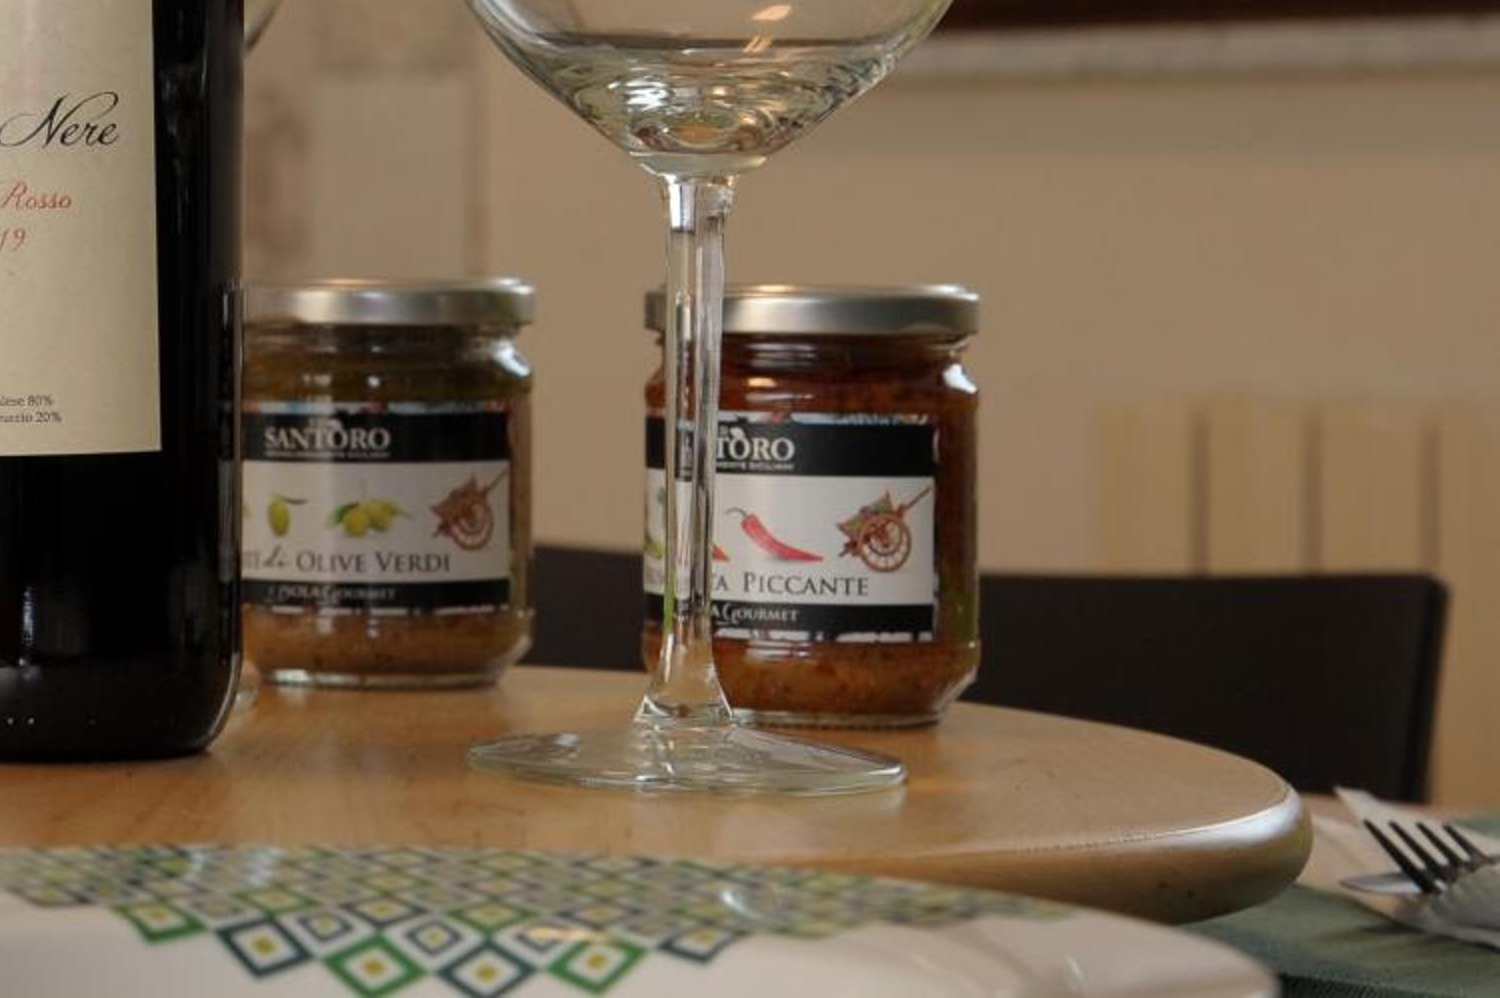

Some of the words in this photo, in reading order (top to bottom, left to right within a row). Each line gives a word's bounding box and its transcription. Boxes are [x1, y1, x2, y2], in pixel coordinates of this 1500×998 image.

[35, 411, 62, 423] 20%
[264, 425, 391, 450] SANTORO
[714, 436, 795, 461] TORO
[296, 550, 367, 571] OLIVE
[375, 550, 451, 572] VERDI
[742, 571, 869, 596] PICCANTE
